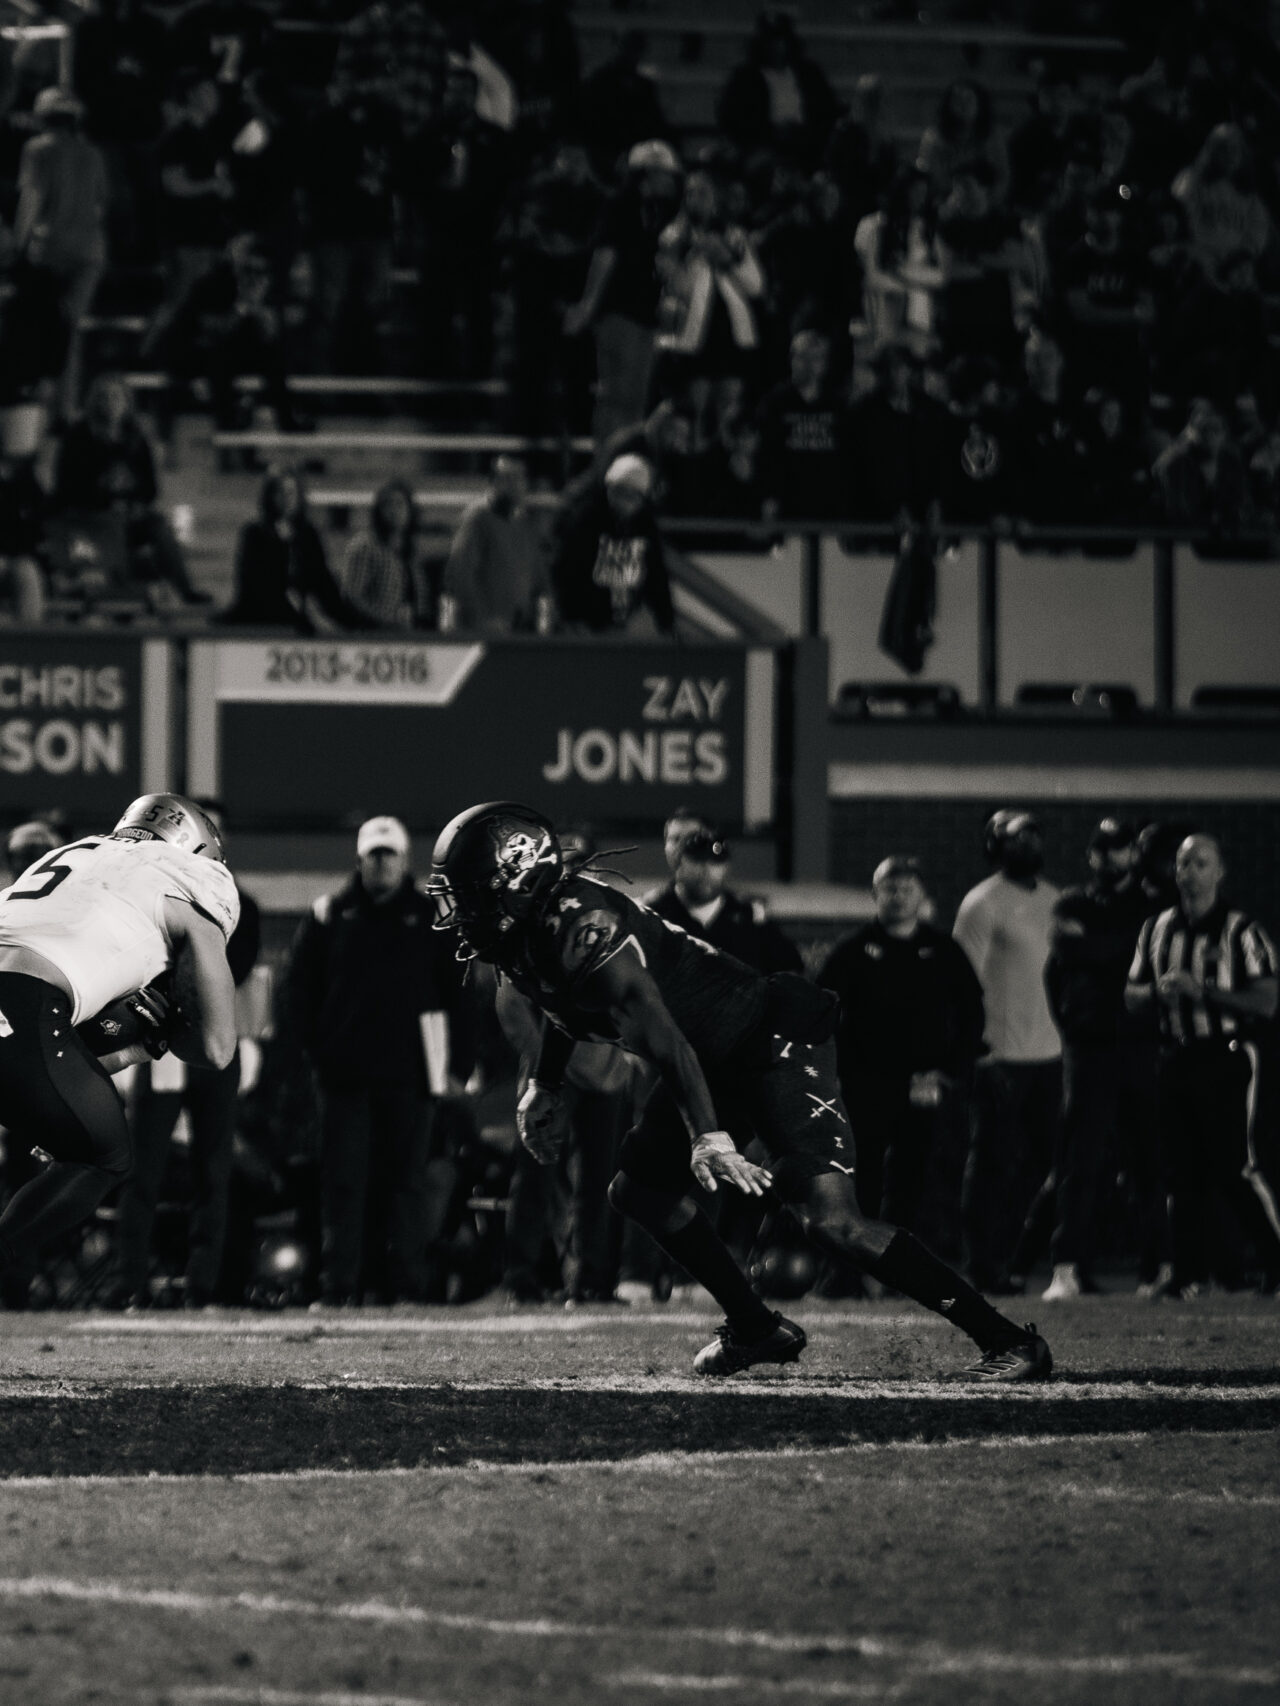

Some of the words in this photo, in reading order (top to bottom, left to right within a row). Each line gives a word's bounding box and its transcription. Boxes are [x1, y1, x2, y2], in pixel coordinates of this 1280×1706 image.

[266, 648, 429, 684] 2013-2016
[640, 675, 728, 722] ZAY
[542, 728, 728, 784] JONES
[145, 804, 165, 822] 5
[6, 842, 101, 901] 5
